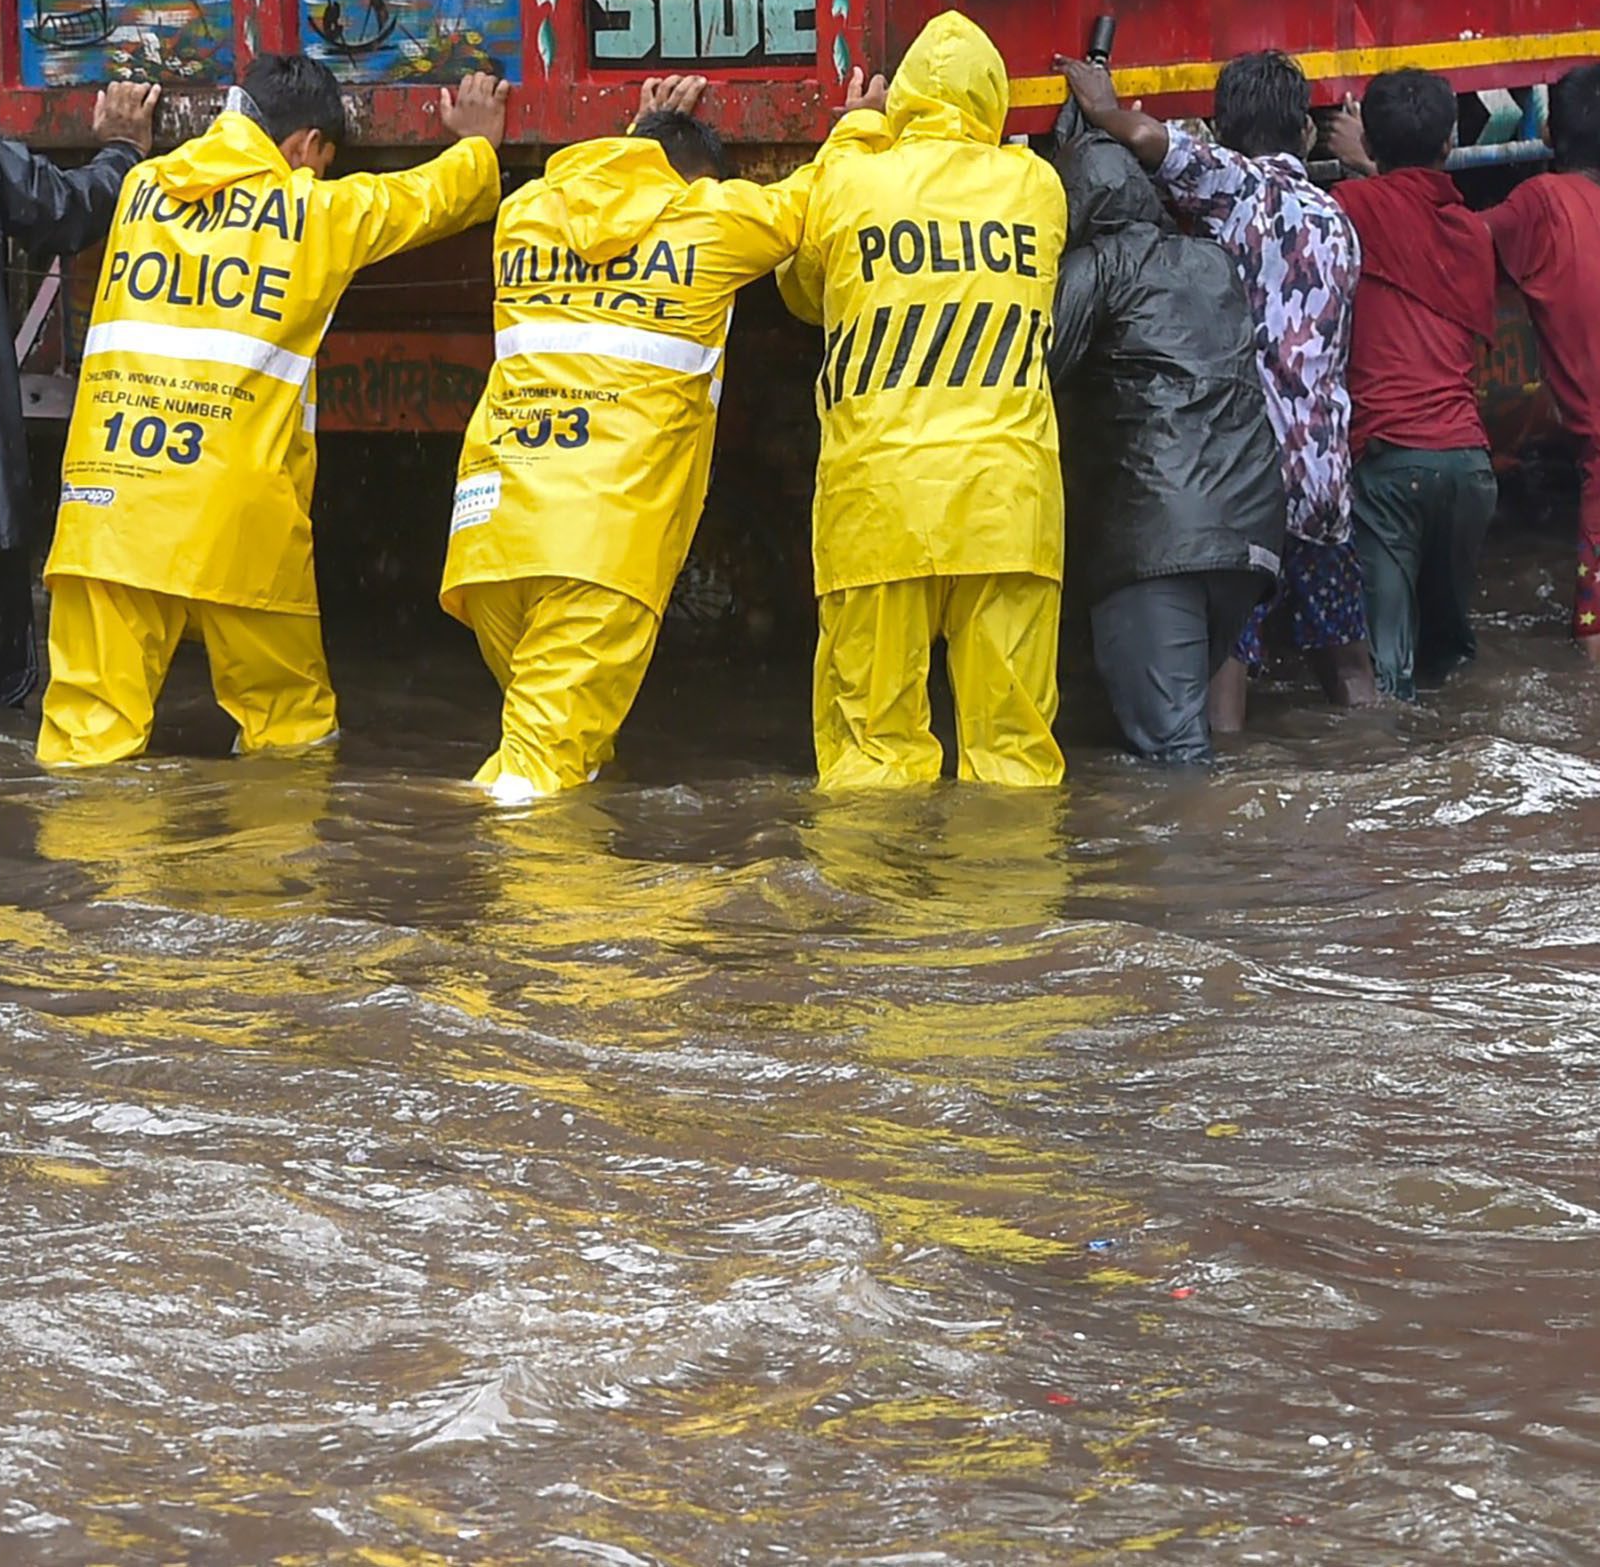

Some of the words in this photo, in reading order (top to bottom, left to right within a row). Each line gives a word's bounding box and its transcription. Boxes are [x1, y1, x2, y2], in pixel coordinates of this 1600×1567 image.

[498, 240, 697, 288] MUMBAI
[856, 217, 1039, 284] POLICE
[103, 251, 292, 322] POLICE
[92, 389, 161, 410] HELPLINE
[164, 398, 233, 421] NUMBER
[128, 370, 167, 388] WOMEN
[180, 378, 219, 396] SENIOR
[103, 411, 204, 465] 103
